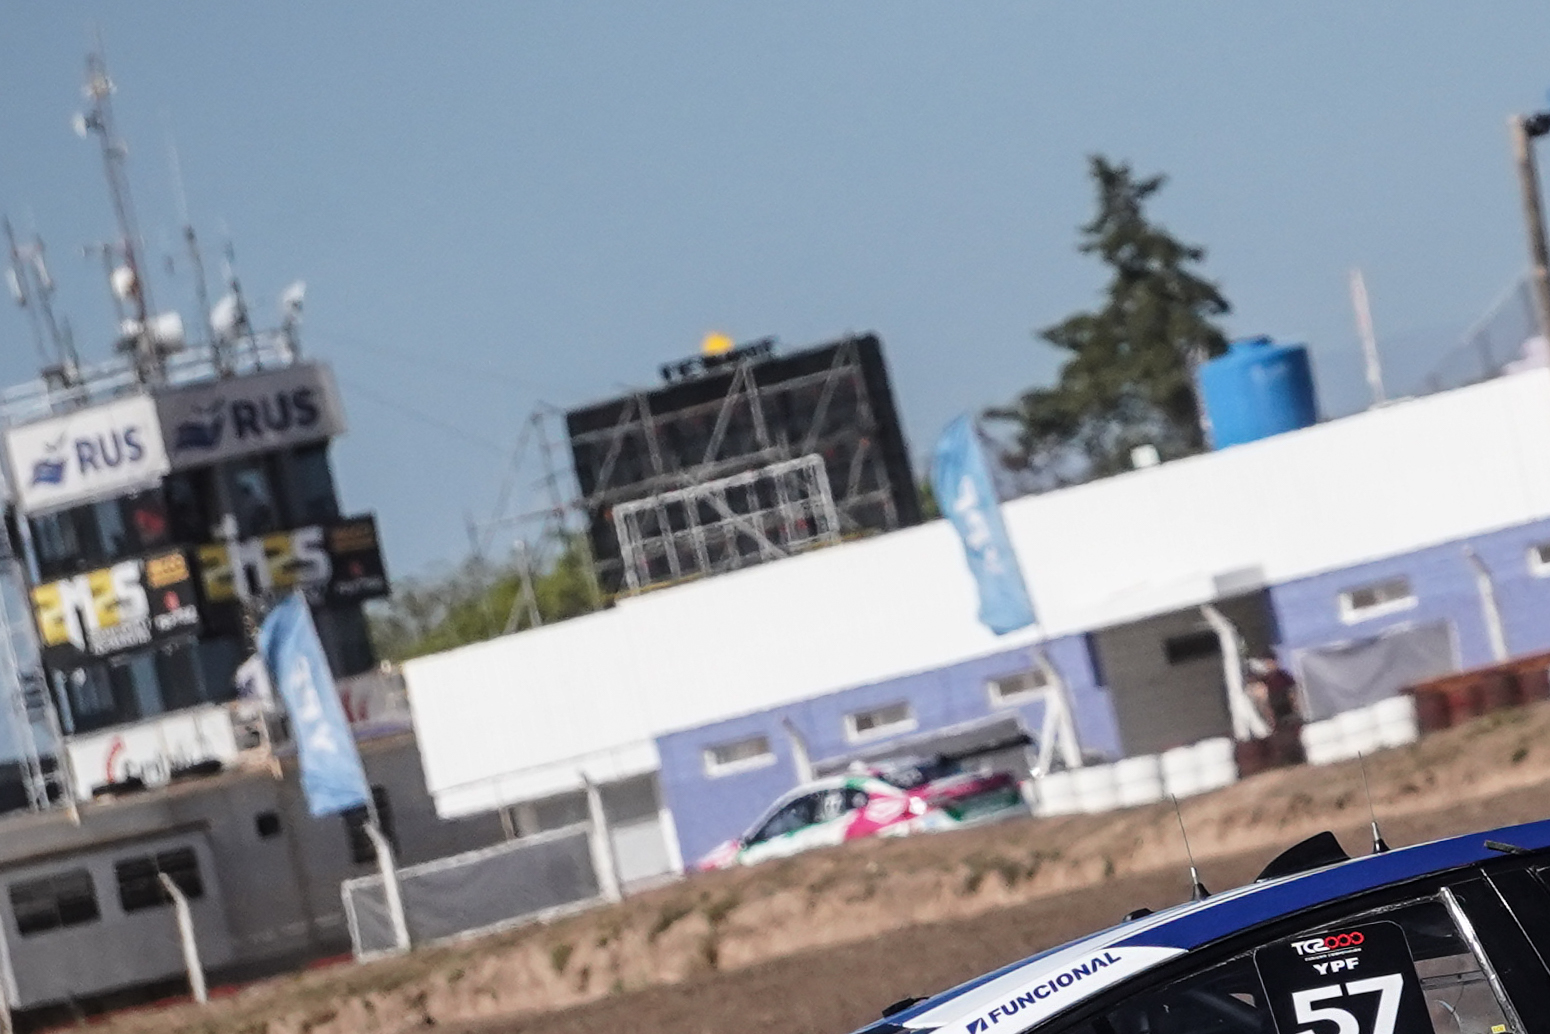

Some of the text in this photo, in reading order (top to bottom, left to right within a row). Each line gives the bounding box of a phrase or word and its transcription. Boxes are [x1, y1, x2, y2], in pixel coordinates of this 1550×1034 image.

[231, 388, 321, 438] RUS
[76, 427, 144, 475] RUS
[1291, 931, 1365, 955] TC2000
[1313, 957, 1359, 975] YPF
[988, 952, 1121, 1025] FUNCIONAL
